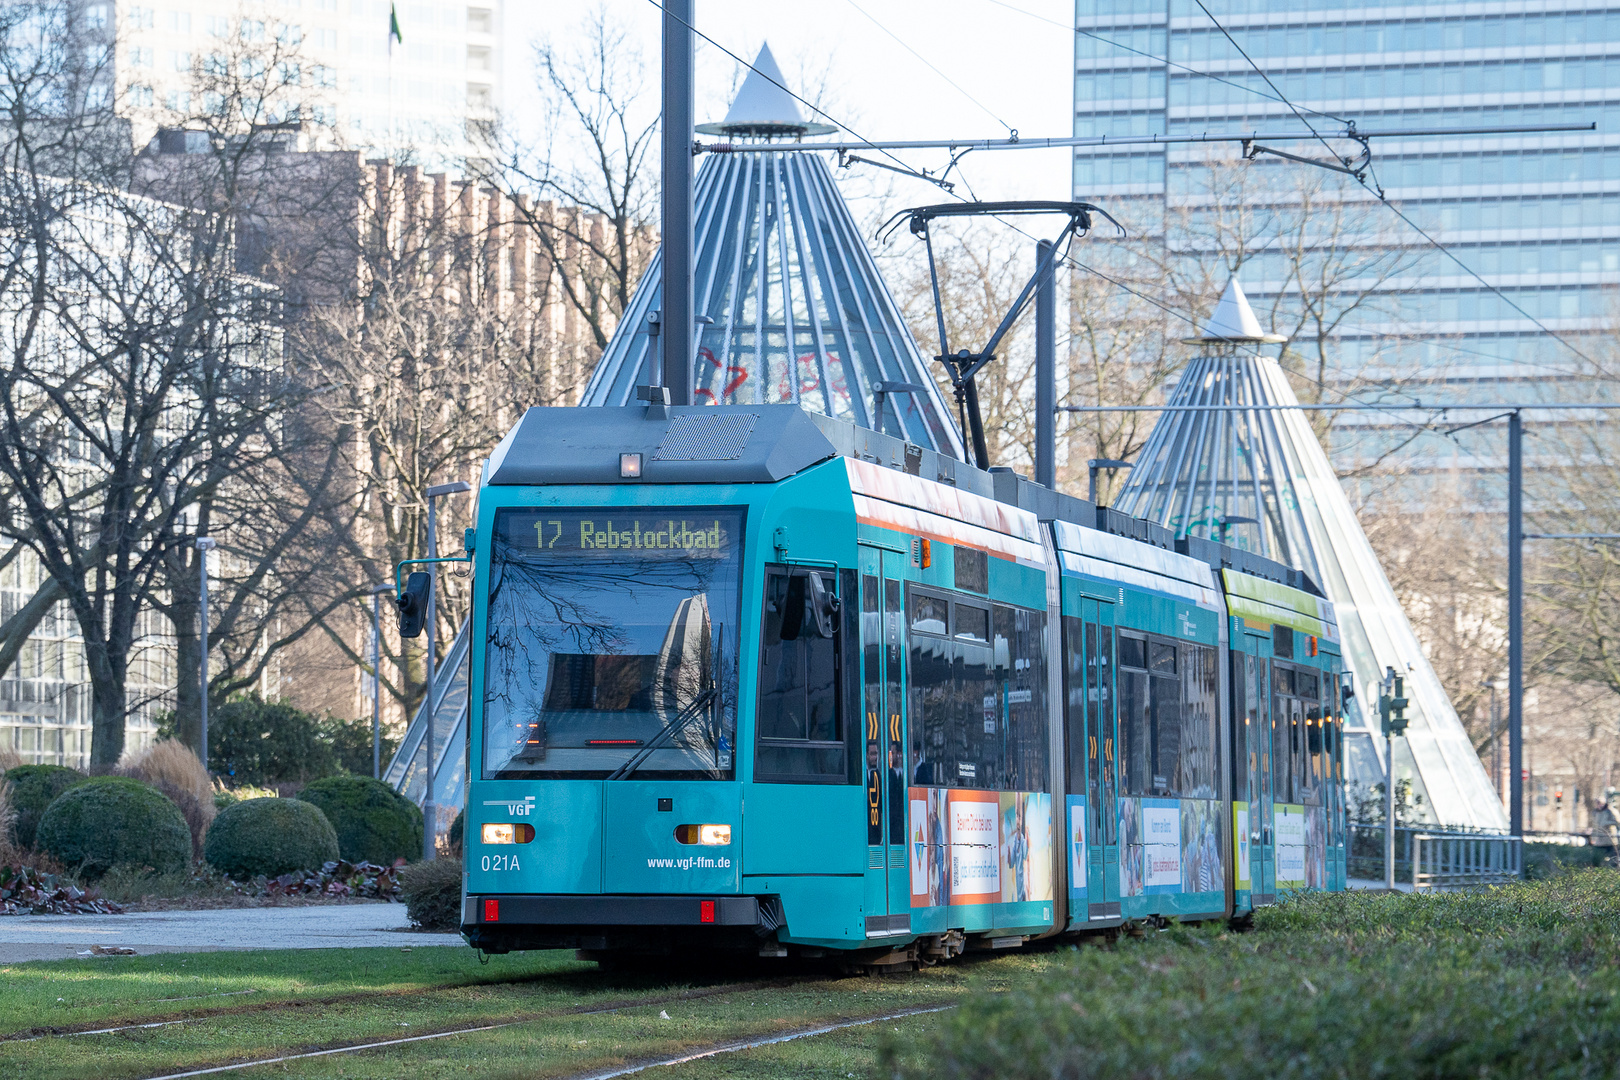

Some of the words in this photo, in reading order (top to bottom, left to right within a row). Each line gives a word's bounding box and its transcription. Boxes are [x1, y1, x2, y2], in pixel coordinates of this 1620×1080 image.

[533, 520, 562, 549] 17
[580, 520, 720, 549] Rebstockbad
[647, 856, 731, 871] www.vgf-ffm.de
